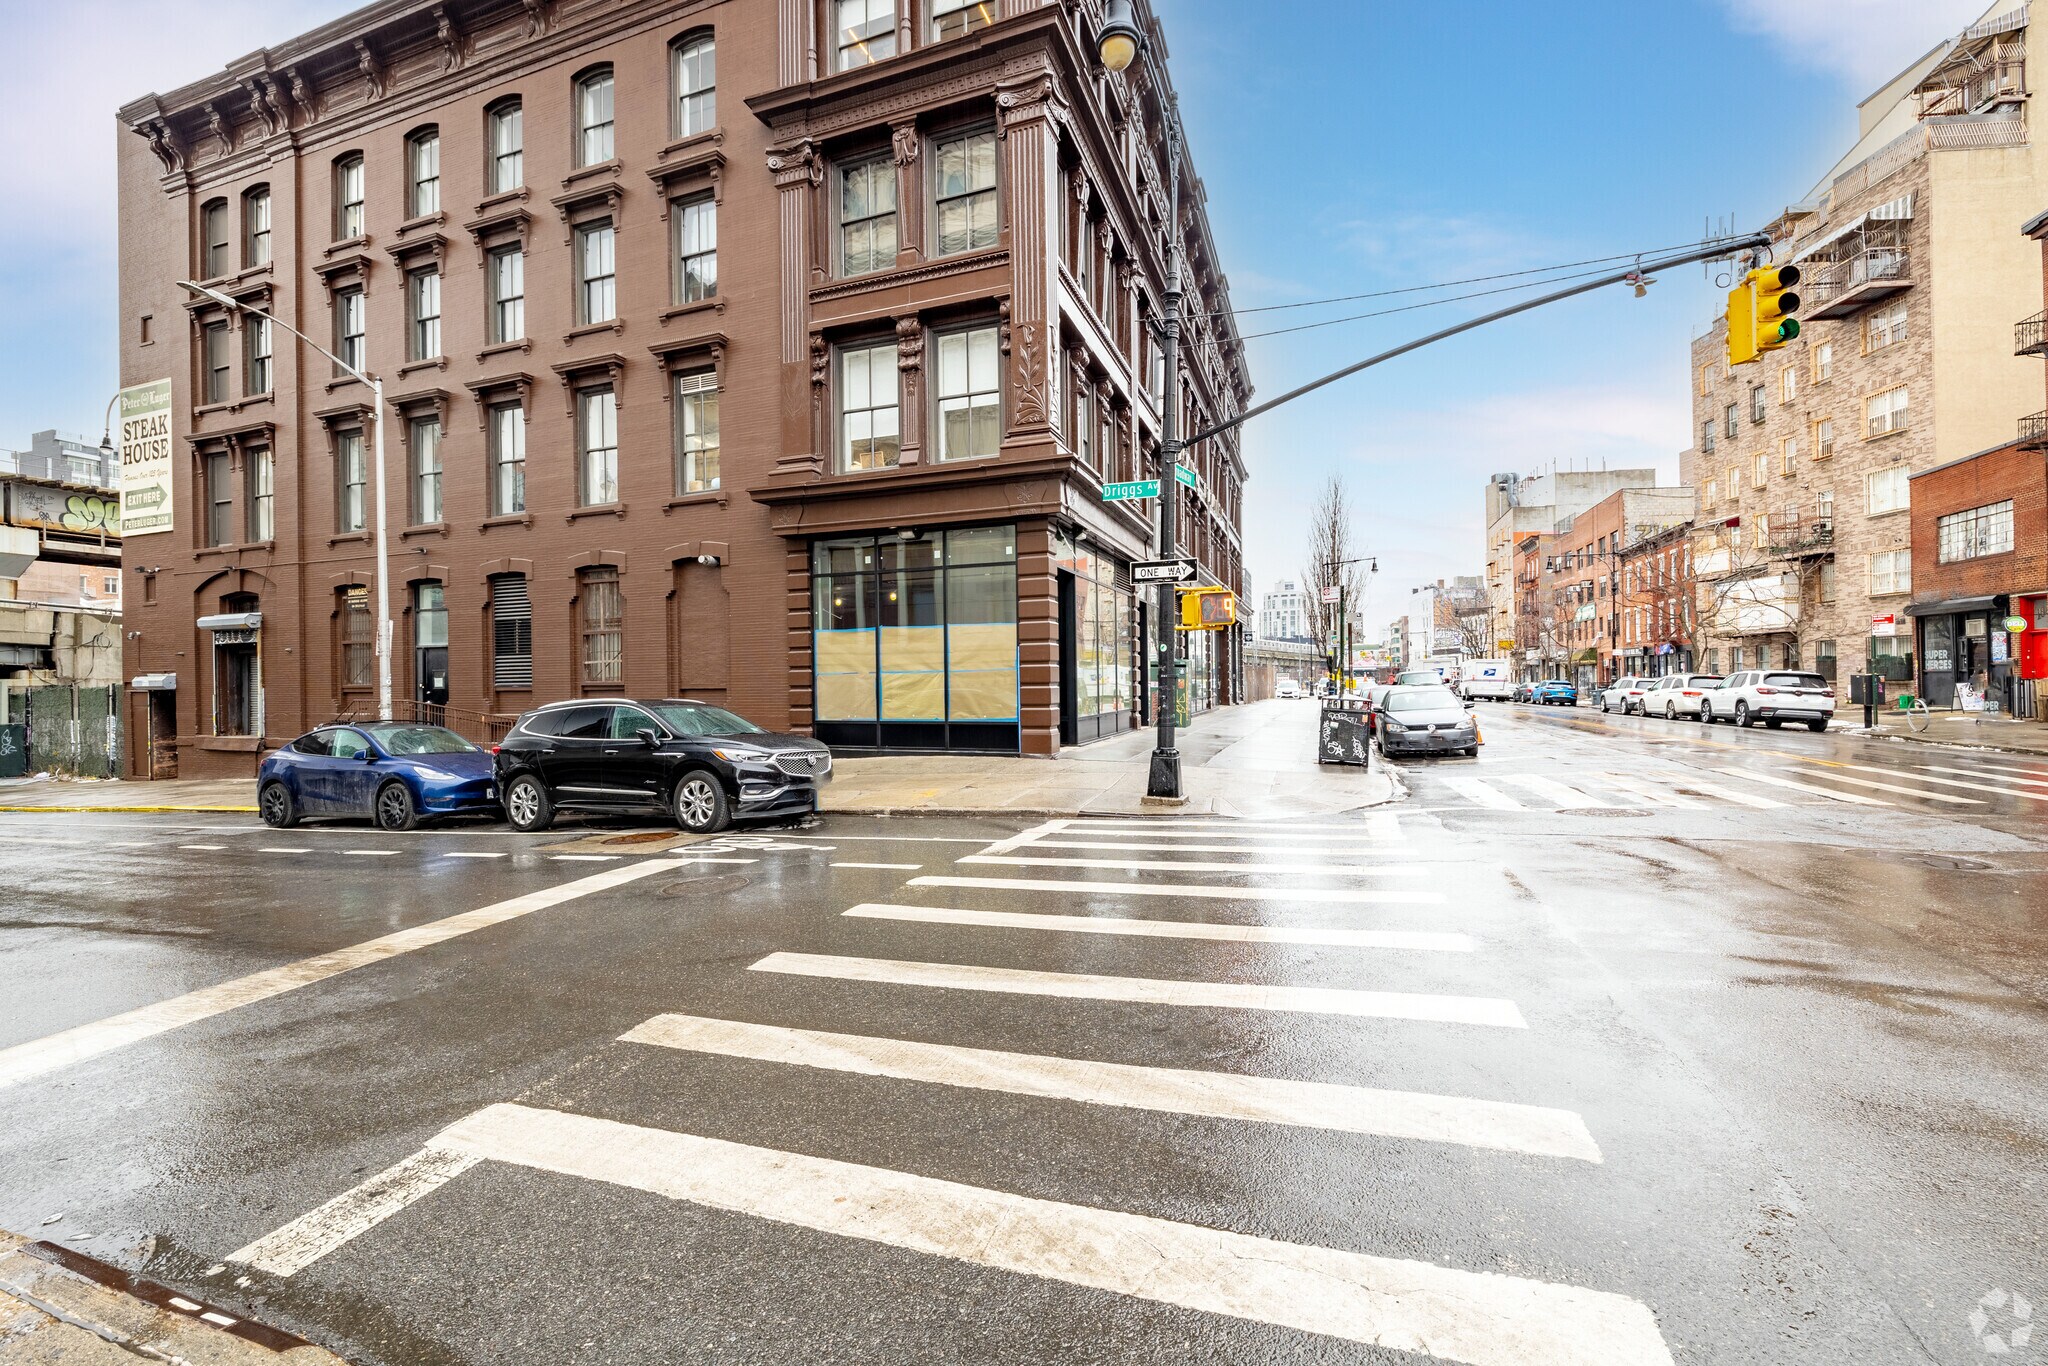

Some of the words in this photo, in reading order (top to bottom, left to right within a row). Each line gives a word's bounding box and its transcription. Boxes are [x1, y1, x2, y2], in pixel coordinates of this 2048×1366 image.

[122, 396, 141, 411] Peter
[149, 390, 170, 405] Luger
[124, 414, 168, 442] STEAK
[123, 438, 168, 465] HOUSE
[127, 493, 143, 506] EXIT
[143, 490, 161, 504] HERE
[1104, 485, 1143, 498] Driggs
[125, 516, 169, 529] PETERLUGER.COM
[1140, 567, 1160, 578] ONE
[1167, 565, 1188, 576] WAY
[1925, 650, 1948, 659] SUPER
[1925, 660, 1952, 669] HEROES
